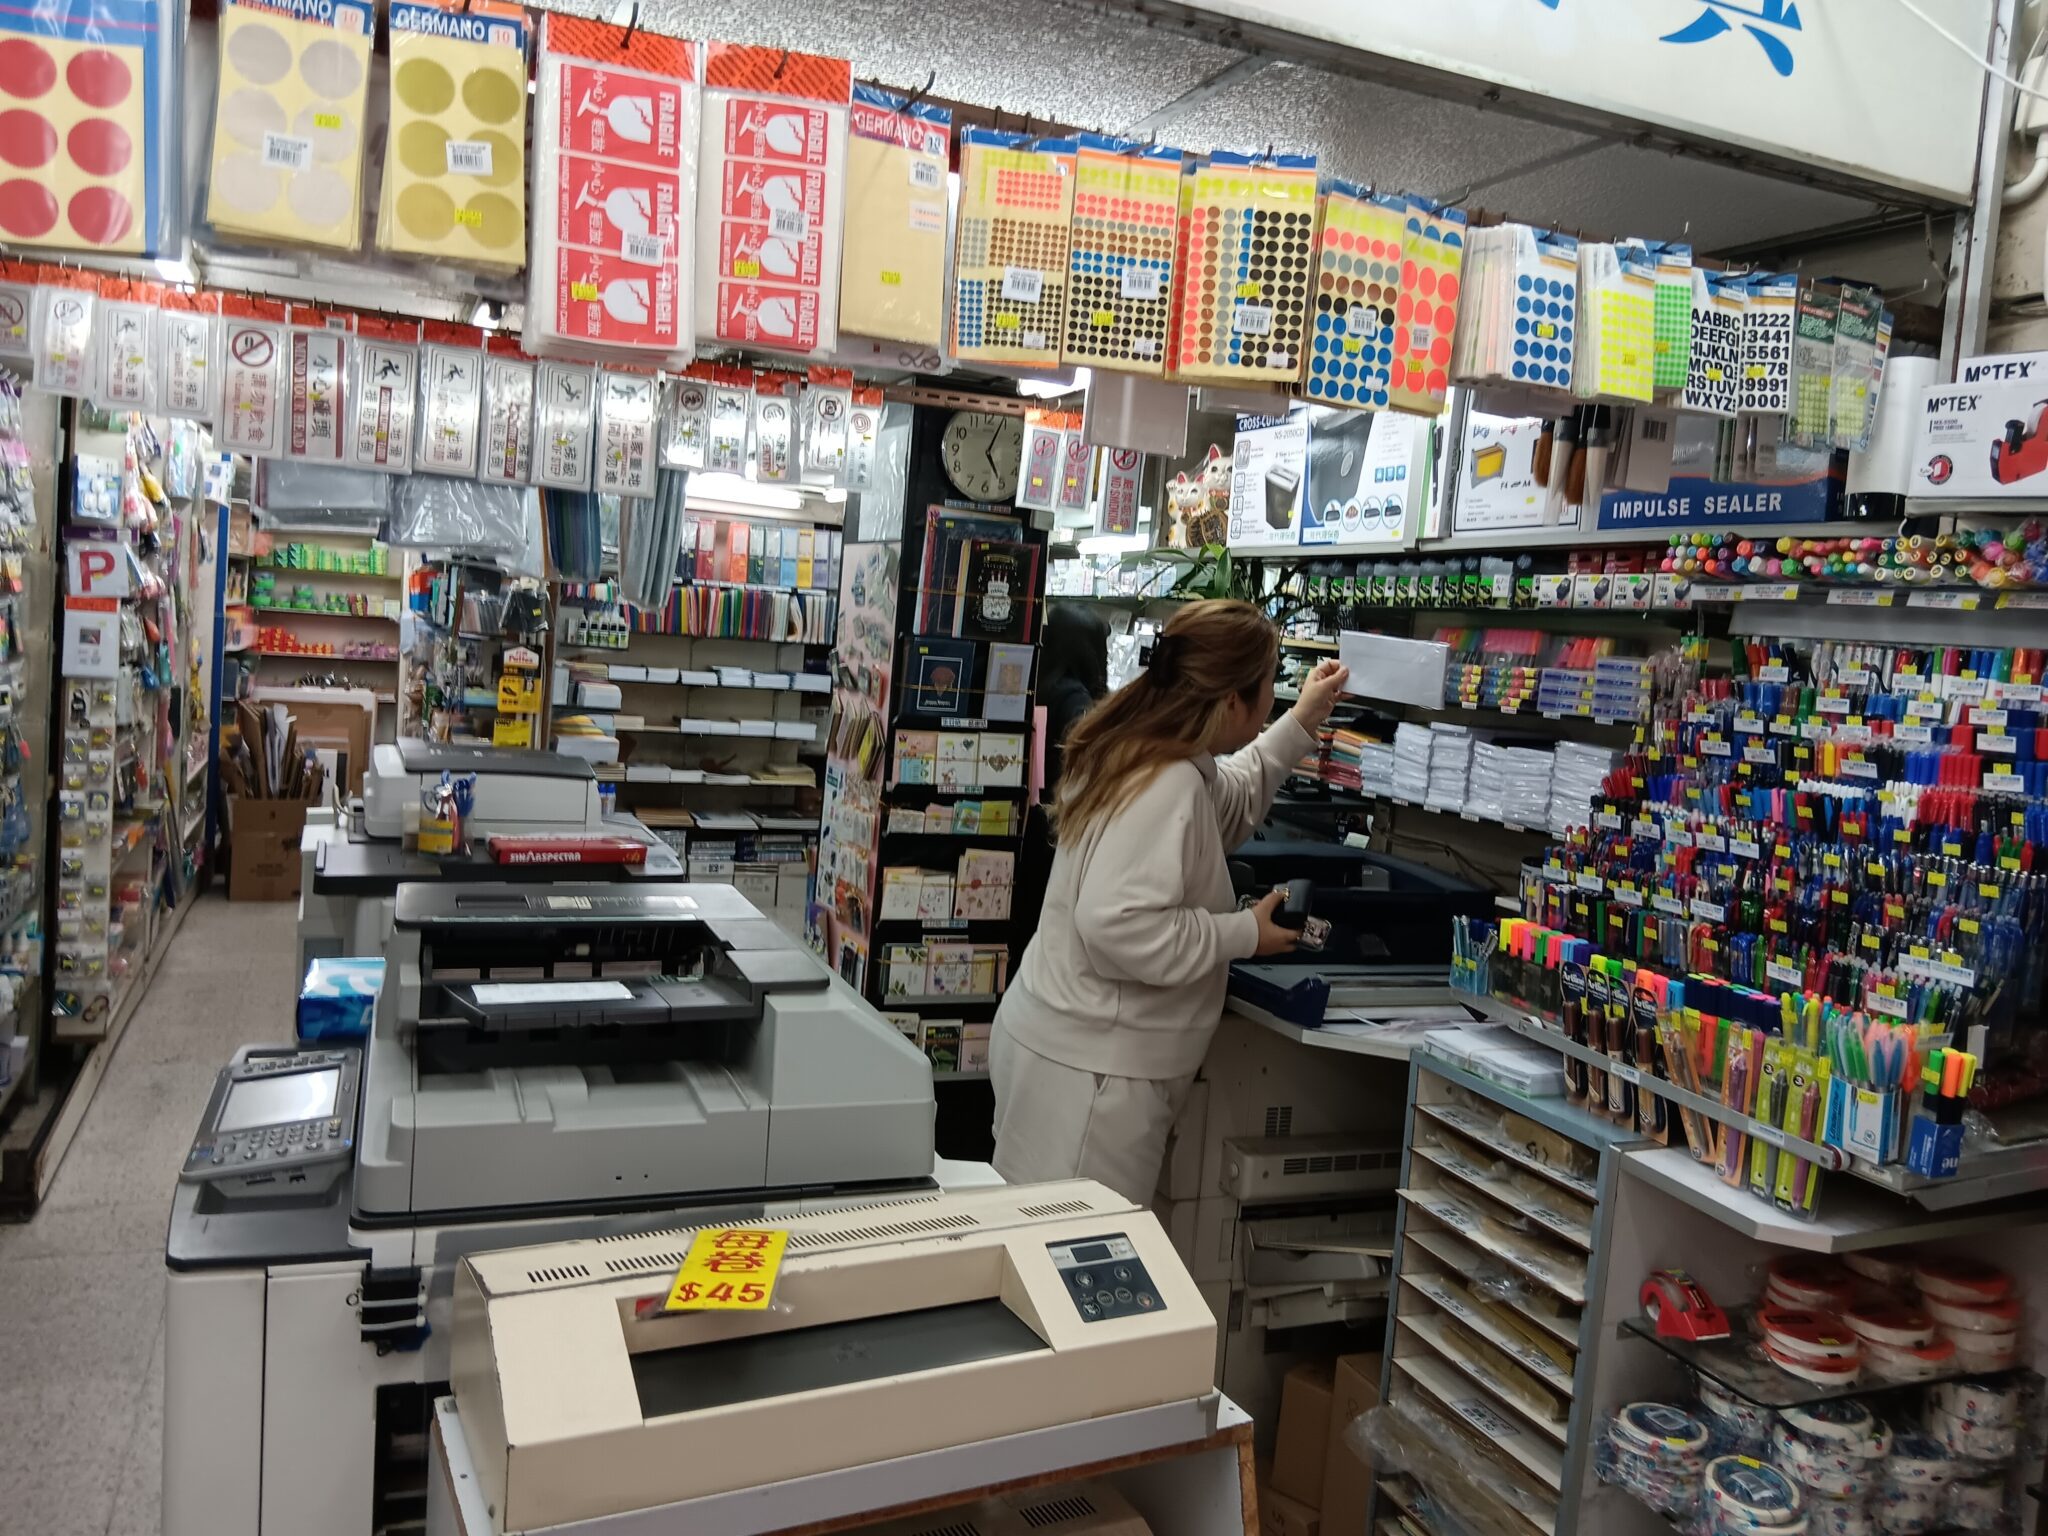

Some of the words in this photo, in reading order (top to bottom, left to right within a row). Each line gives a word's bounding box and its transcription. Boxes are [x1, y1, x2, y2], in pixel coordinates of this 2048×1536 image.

[397, 7, 486, 40] GERMANO
[493, 31, 510, 44] 10
[658, 91, 676, 157] FRAGILE
[807, 109, 824, 163] FRAGILE
[856, 110, 924, 145] GERMANO
[804, 170, 821, 225] FRAGILE
[801, 231, 819, 285] FRAGILE
[655, 271, 672, 335] FRAGILE
[798, 291, 816, 345] FRAGILE
[1691, 308, 1741, 332] AABBC
[294, 341, 307, 375] MIND
[294, 375, 306, 412] YOUR
[1686, 373, 1737, 396] RSTUV
[293, 414, 305, 449] HEAD
[956, 426, 967, 440] 10
[969, 414, 979, 428] 11
[951, 444, 959, 456] 9
[1013, 433, 1021, 446] 2
[953, 460, 961, 473] 8
[966, 475, 975, 487] 7
[981, 480, 989, 494] 6
[1612, 497, 1690, 519] IMPULSE
[1704, 493, 1782, 515] SEALER
[80, 550, 115, 593] P
[702, 1229, 775, 1273] 每卷
